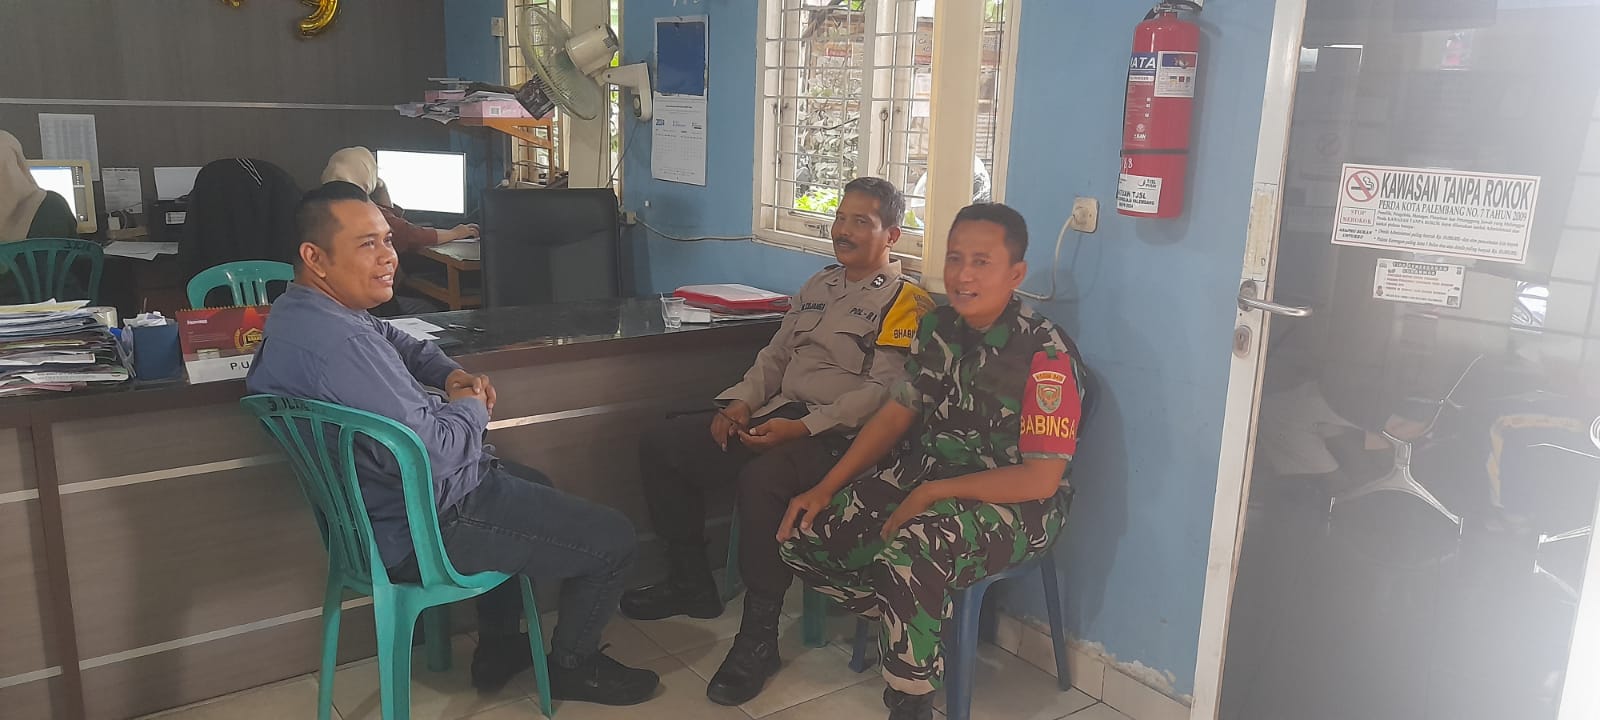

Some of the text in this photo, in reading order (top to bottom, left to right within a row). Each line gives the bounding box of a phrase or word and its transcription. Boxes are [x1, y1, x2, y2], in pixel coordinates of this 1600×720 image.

[1380, 172, 1533, 210] KAWASAN TANPA ROKOK
[1379, 199, 1400, 211] PERDA
[1402, 202, 1421, 213] KOTA
[1422, 204, 1466, 217] PALEMBANG
[1466, 207, 1479, 218] NO.
[1480, 208, 1485, 218] 7
[1486, 209, 1512, 220] TAHUN
[893, 329, 915, 339] BHABI
[1020, 414, 1075, 441] BABINSA
